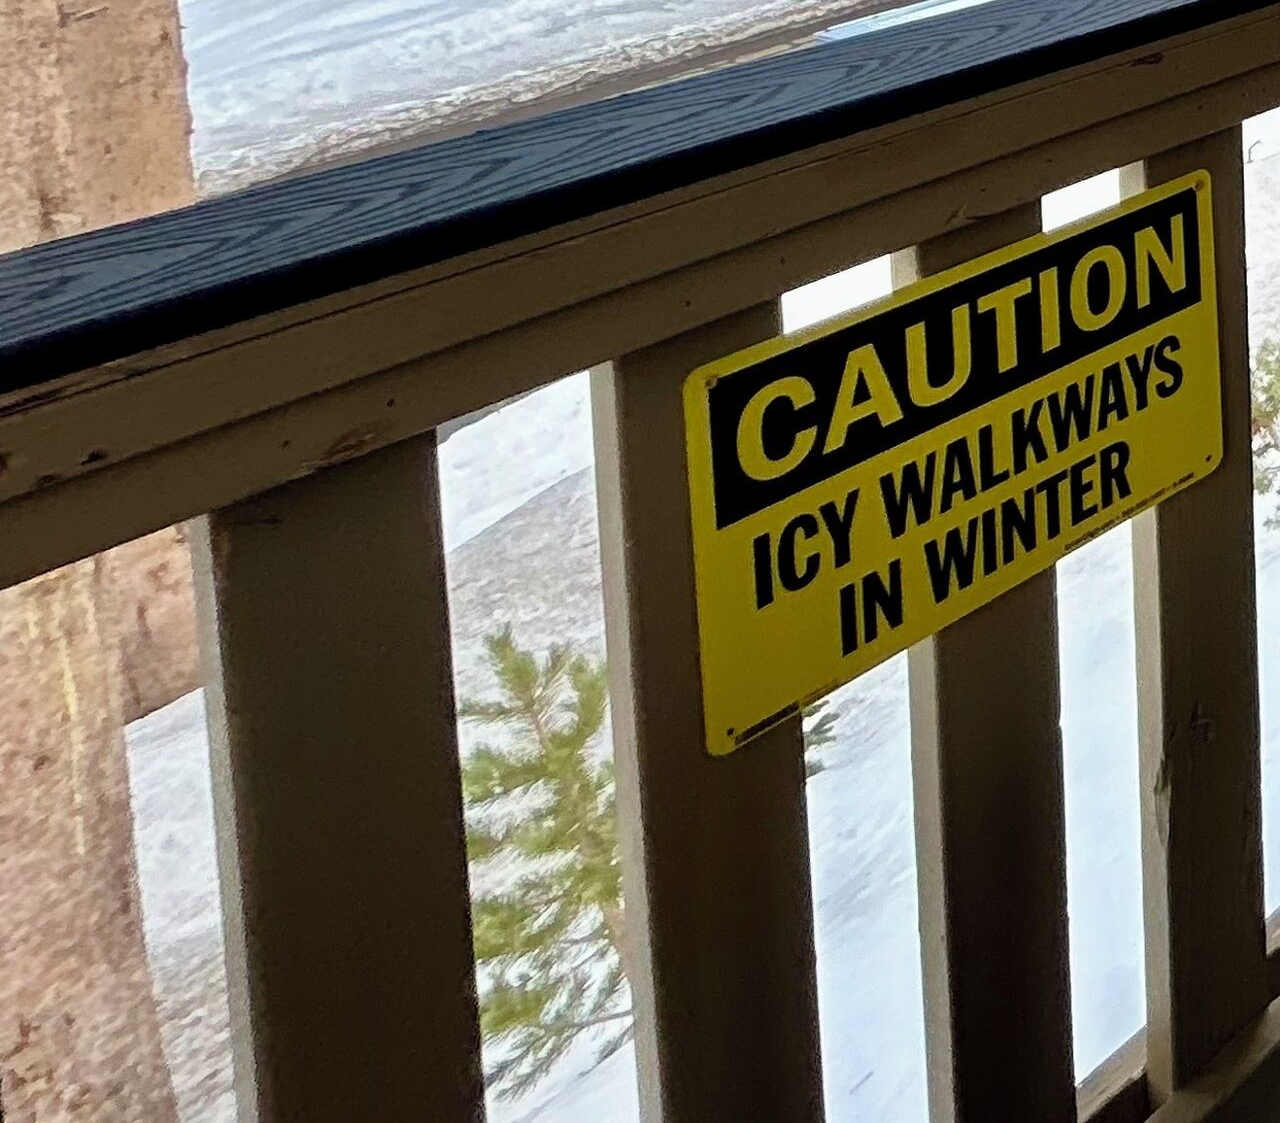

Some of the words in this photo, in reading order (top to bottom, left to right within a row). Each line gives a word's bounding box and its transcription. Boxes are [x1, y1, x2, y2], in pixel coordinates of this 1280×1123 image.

[736, 213, 1186, 482] CAUTION
[753, 489, 861, 611] ICY
[880, 335, 1184, 540] WALKWAYS
[838, 559, 904, 658] IN
[923, 441, 1133, 606] WINTER
